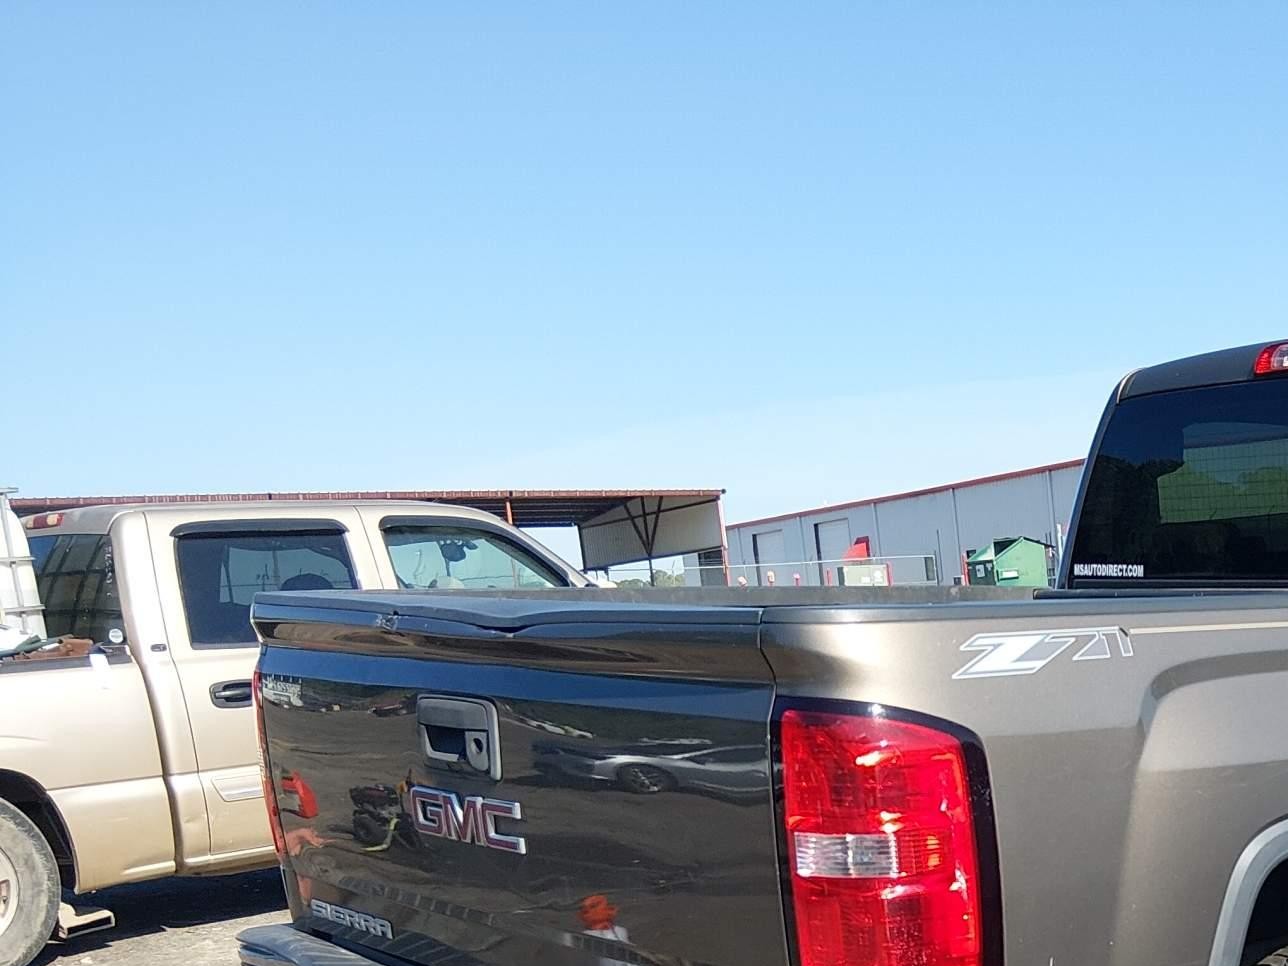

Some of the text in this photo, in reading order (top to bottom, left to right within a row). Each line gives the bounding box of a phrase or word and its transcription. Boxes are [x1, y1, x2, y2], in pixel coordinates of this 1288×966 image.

[1073, 563, 1144, 577] MSAUTODIRECT.COM
[952, 626, 1134, 680] Z71
[410, 786, 527, 855] GMC
[310, 898, 393, 940] SIERRA
